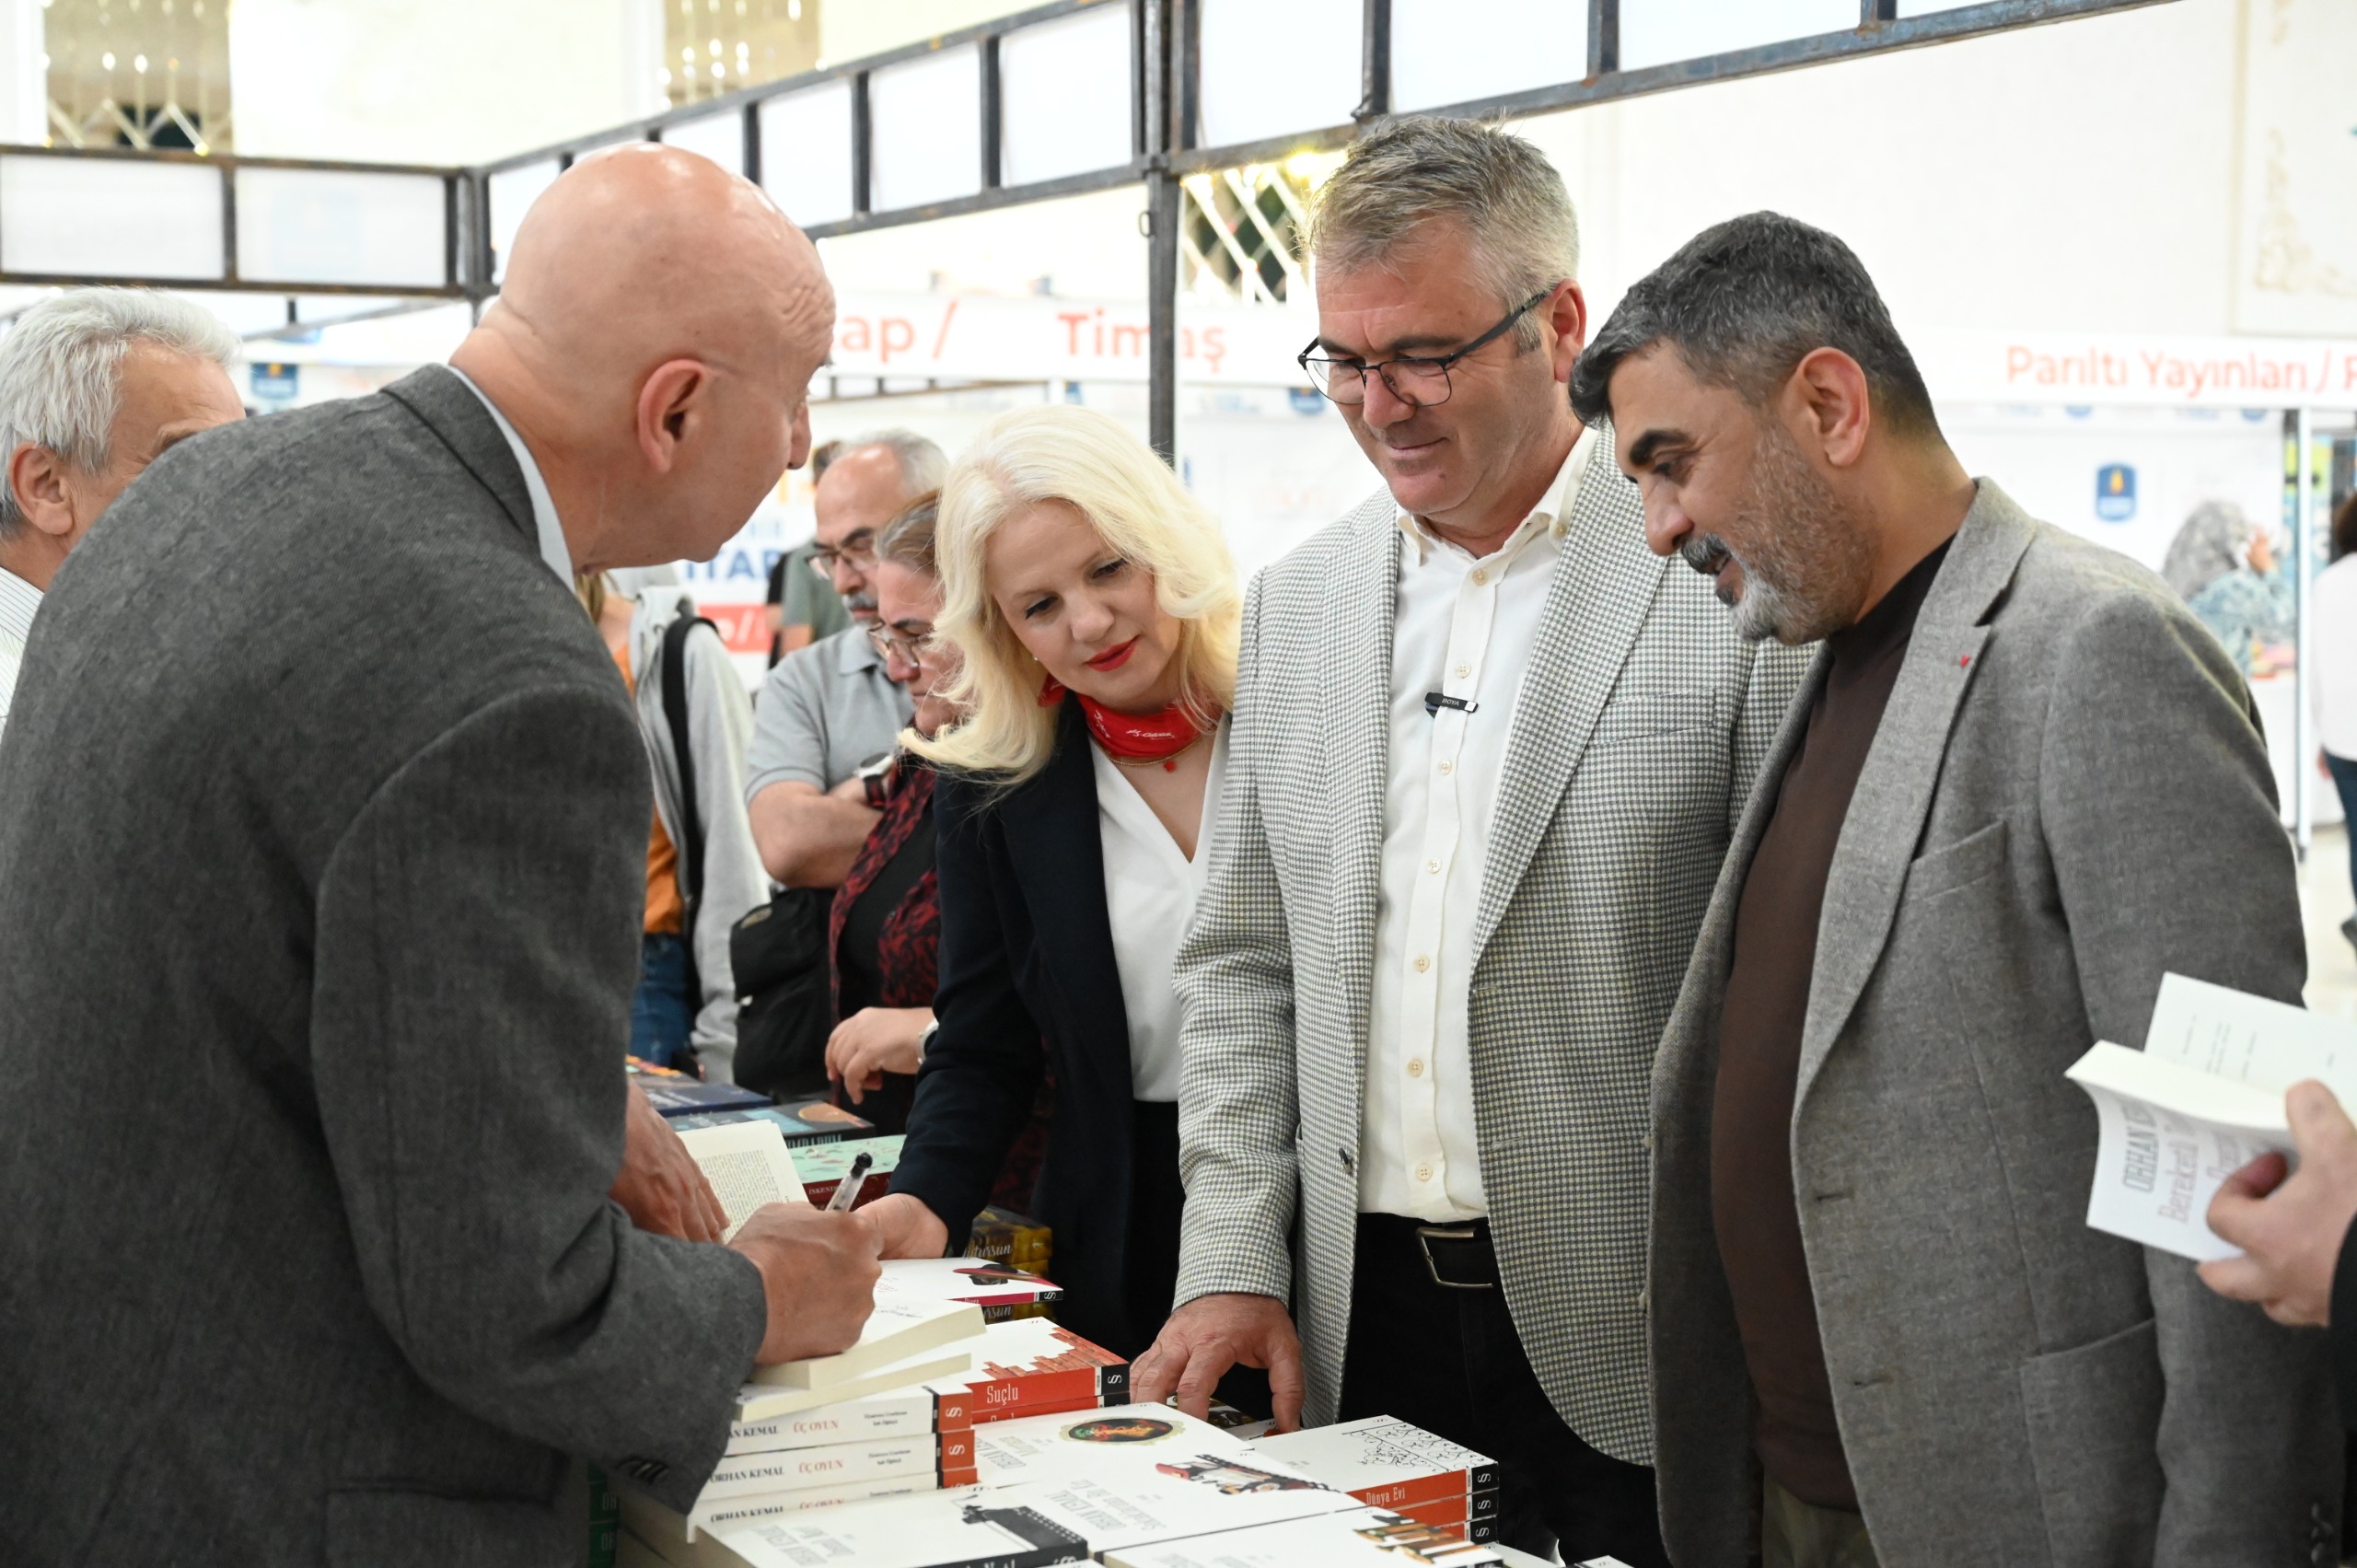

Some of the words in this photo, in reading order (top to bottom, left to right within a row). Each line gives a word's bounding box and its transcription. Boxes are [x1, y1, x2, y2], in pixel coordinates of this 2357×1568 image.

[831, 316, 915, 364] ap
[986, 1383, 1019, 1406] Suçlu
[743, 1425, 779, 1438] KEMAL
[809, 1419, 840, 1432] OYUN
[710, 1470, 747, 1484] ORHAN
[749, 1466, 784, 1479] KEMAL
[815, 1458, 844, 1471] OYUN
[1365, 1491, 1390, 1507] Dünya
[1393, 1486, 1406, 1502] Evi
